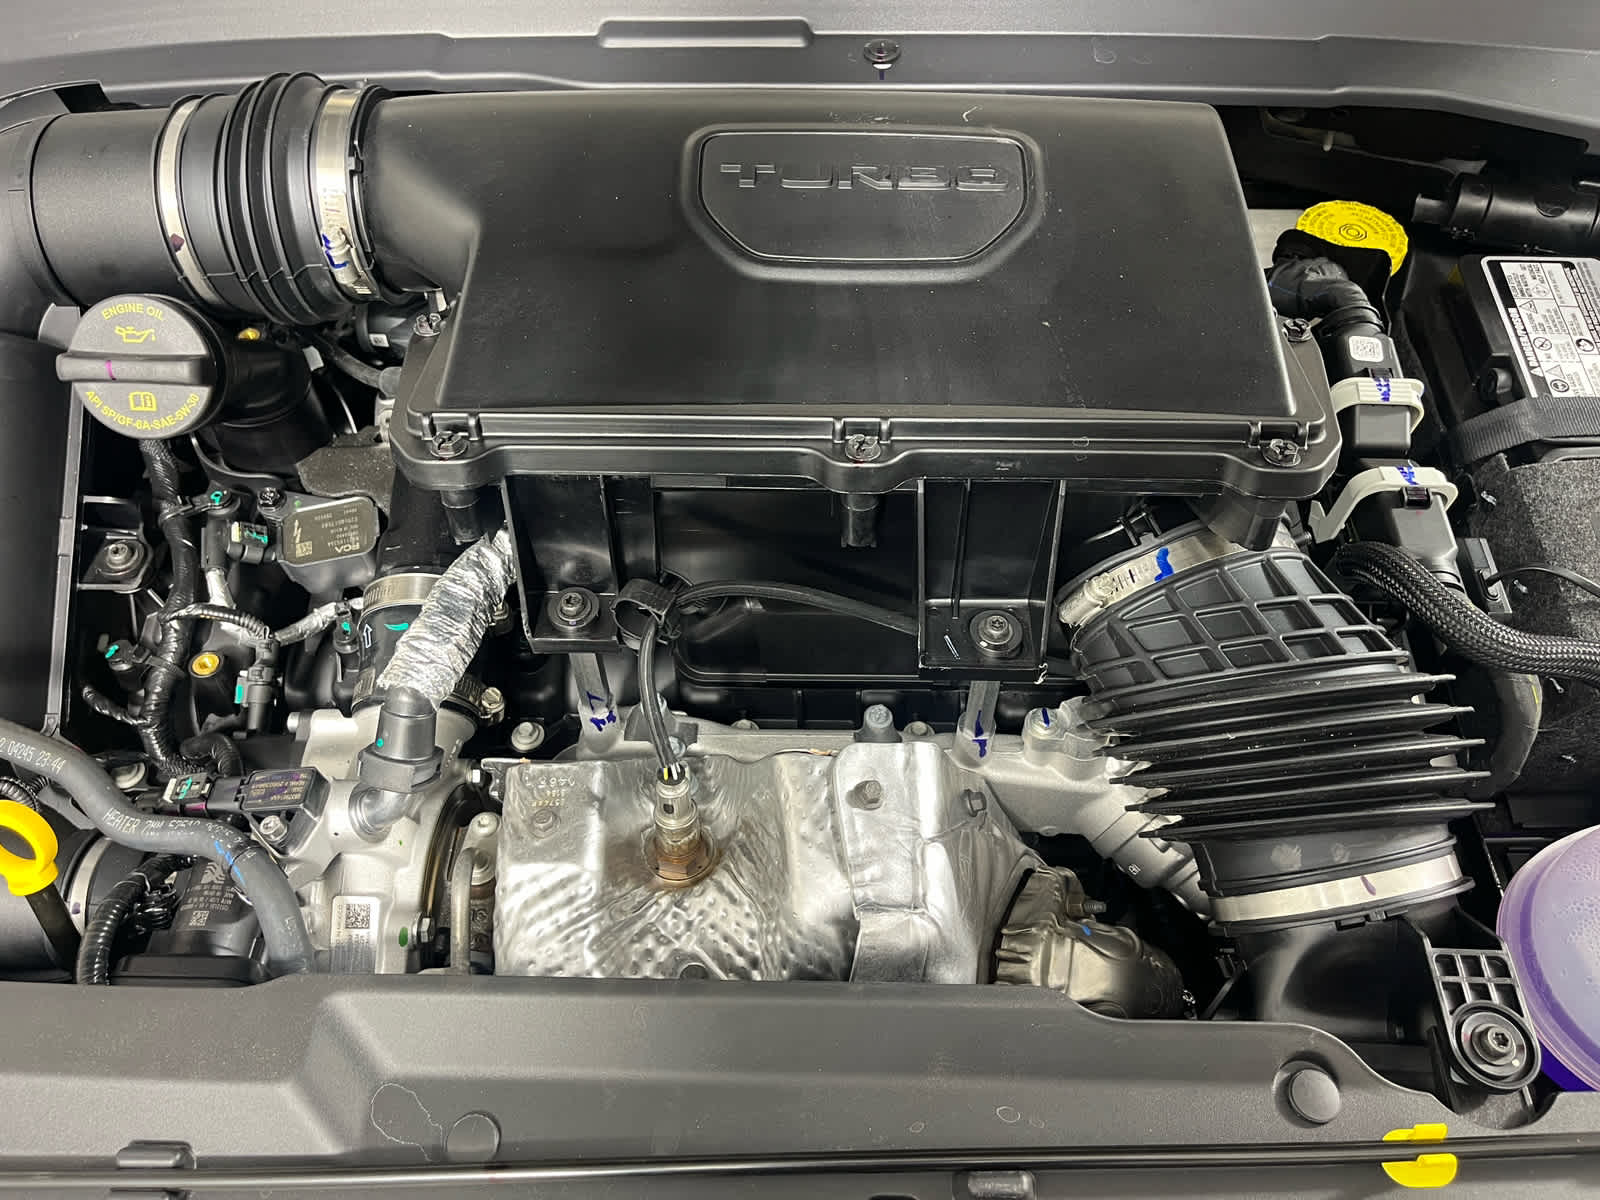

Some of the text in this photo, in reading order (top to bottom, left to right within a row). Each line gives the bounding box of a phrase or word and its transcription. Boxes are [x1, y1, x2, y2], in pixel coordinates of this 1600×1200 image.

[719, 163, 1007, 191] TURBO
[102, 303, 164, 321] ENGINE OIL
[85, 391, 103, 409] API
[102, 807, 141, 834] HEATER
